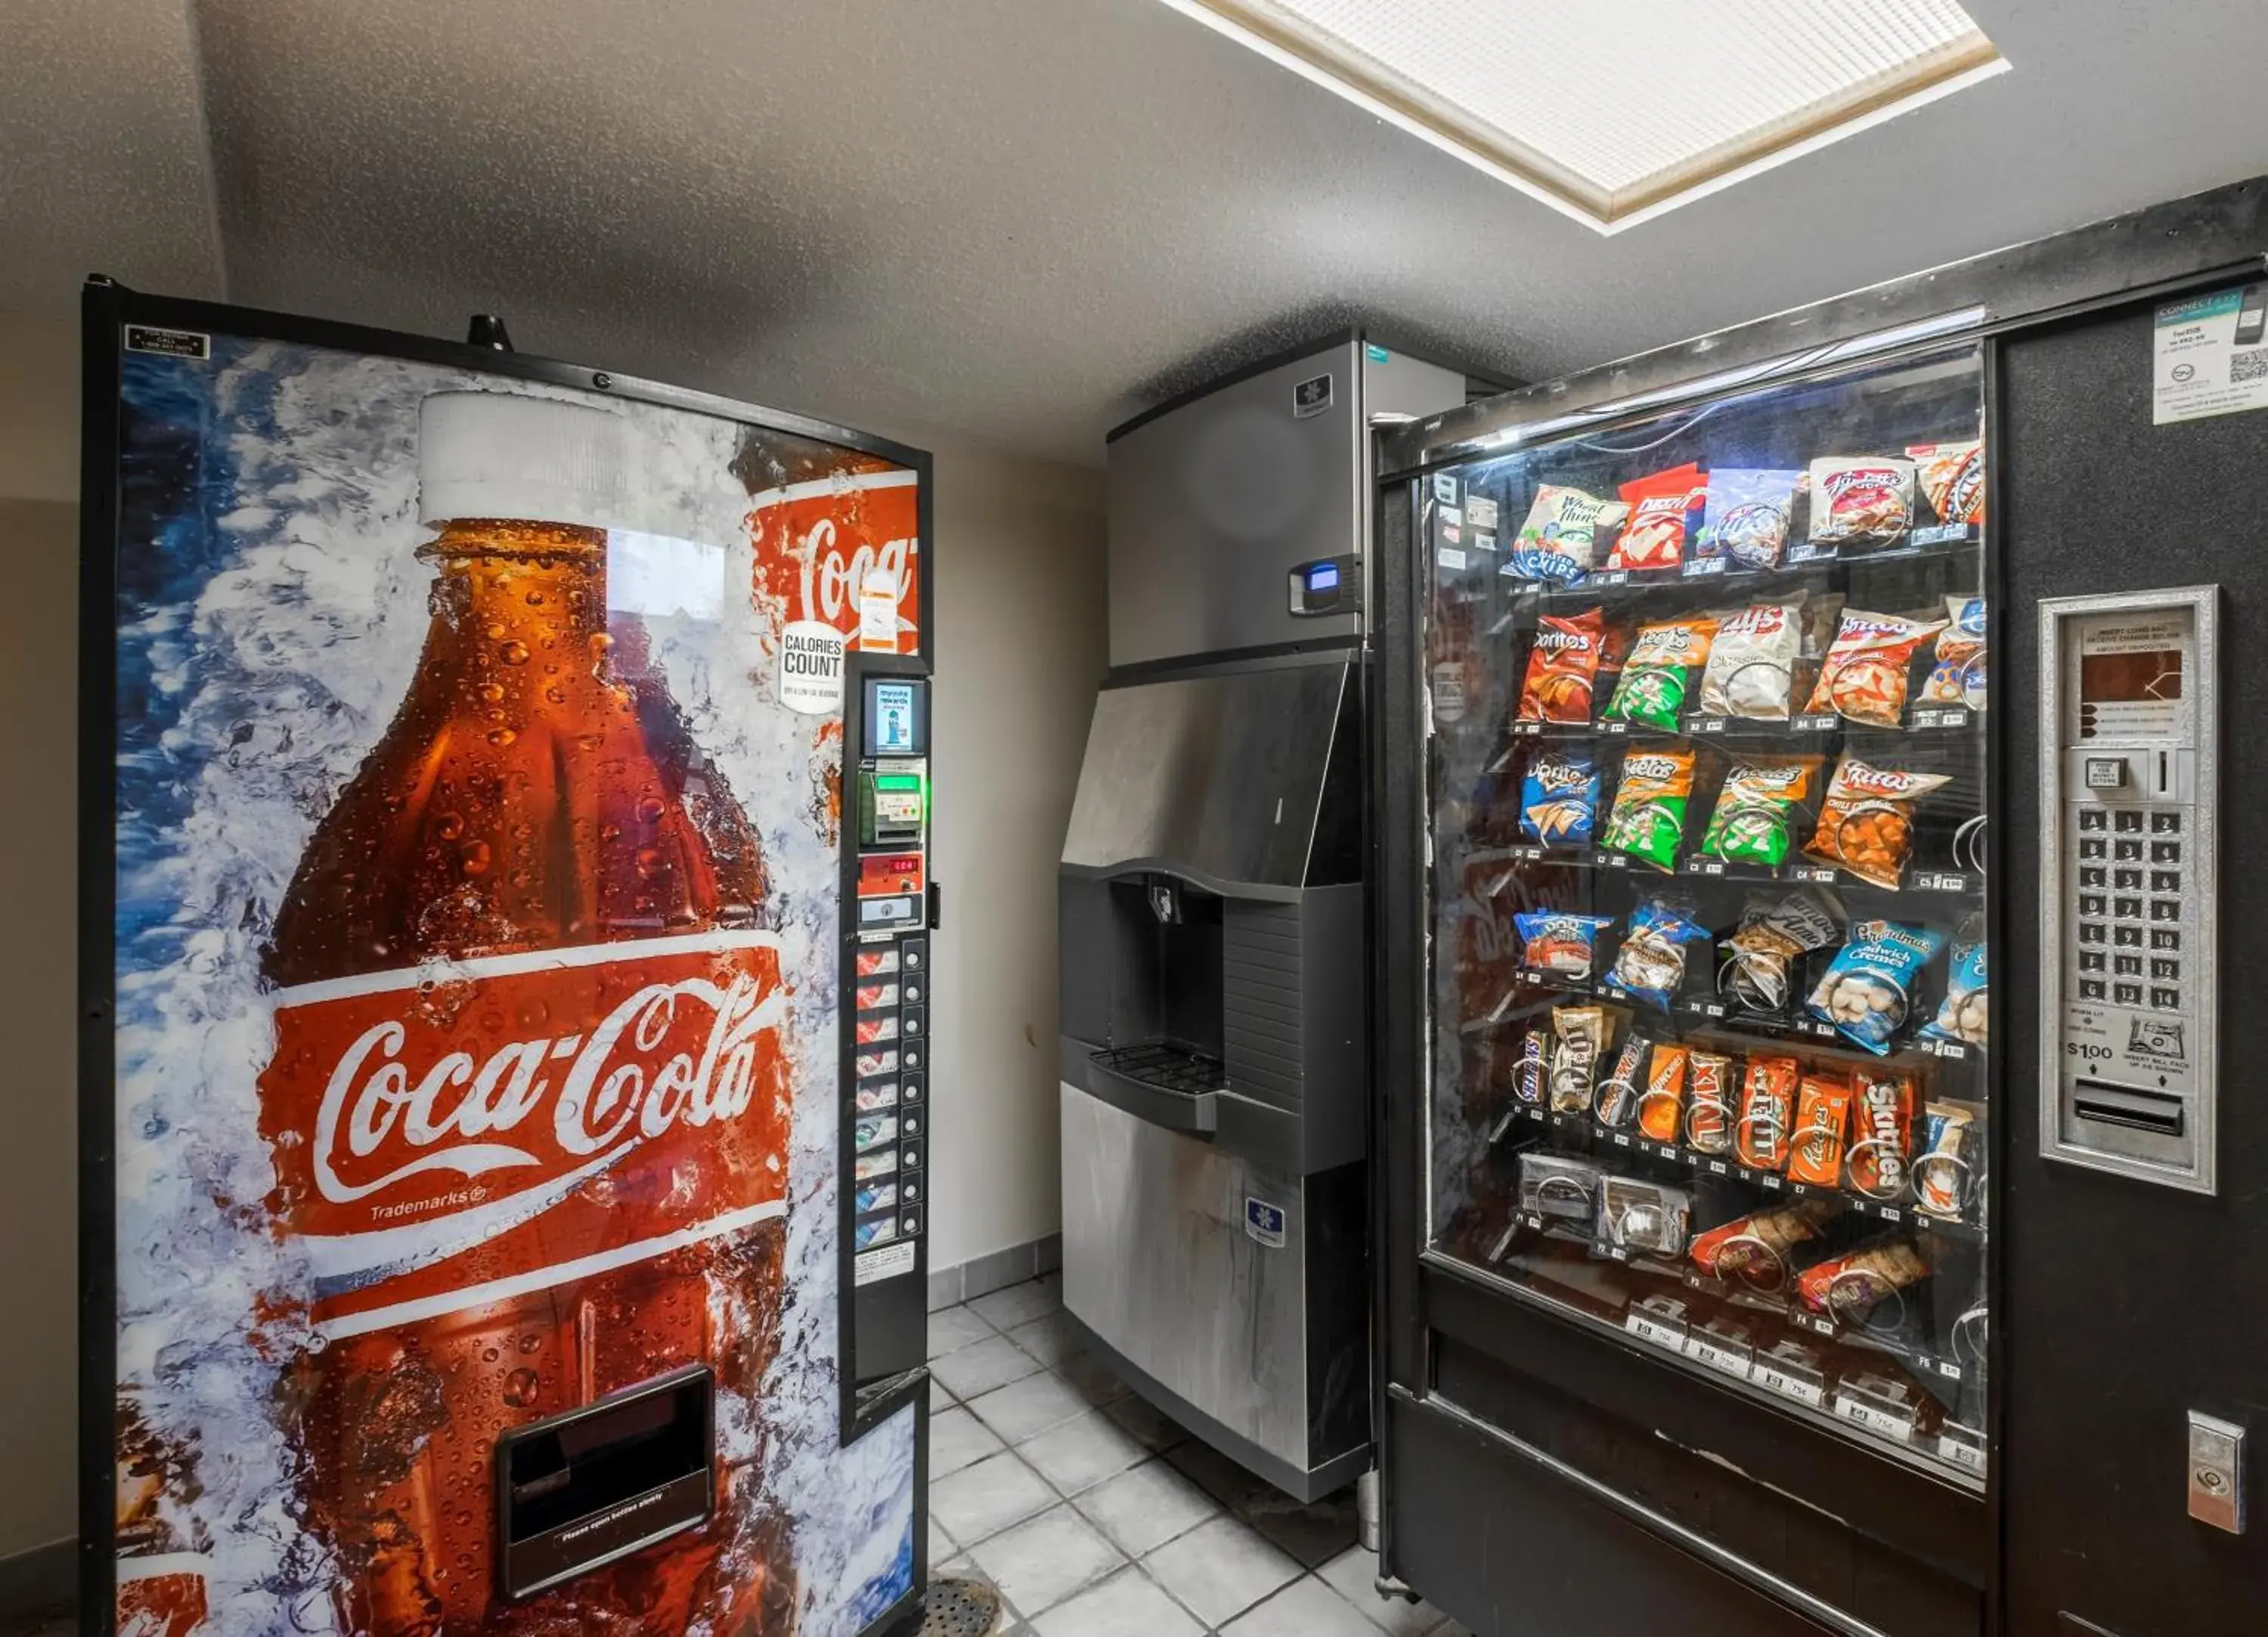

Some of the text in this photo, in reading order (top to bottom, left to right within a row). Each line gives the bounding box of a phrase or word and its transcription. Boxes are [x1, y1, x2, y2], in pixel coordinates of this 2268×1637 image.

[1562, 495, 1606, 514] Wheat
[785, 634, 841, 655] CALORIES
[785, 652, 841, 678] COUNT
[2089, 815, 2098, 826] A
[2127, 816, 2132, 828] 1
[2162, 817, 2170, 829] 2
[2089, 843, 2097, 855] B
[2124, 844, 2133, 856] 3
[2161, 846, 2170, 859] 4
[2089, 871, 2097, 883] C
[2125, 873, 2133, 885] 5
[2161, 876, 2170, 888] 6
[2089, 899, 2097, 910] D
[2124, 902, 2133, 914] 7
[2161, 905, 2170, 916] 8
[2089, 927, 2096, 939] E
[2124, 930, 2133, 942] 9
[2158, 933, 2173, 945] 10
[2089, 955, 2096, 967] F
[2121, 958, 2136, 971] 11
[2158, 963, 2172, 976] 12
[2088, 983, 2096, 995] G
[2121, 987, 2135, 999] 13
[2158, 992, 2172, 1004] 14
[2068, 1042, 2113, 1060] $1.00
[313, 973, 786, 1203] Coca-Cola
[1867, 1085, 1901, 1187] Skittles
